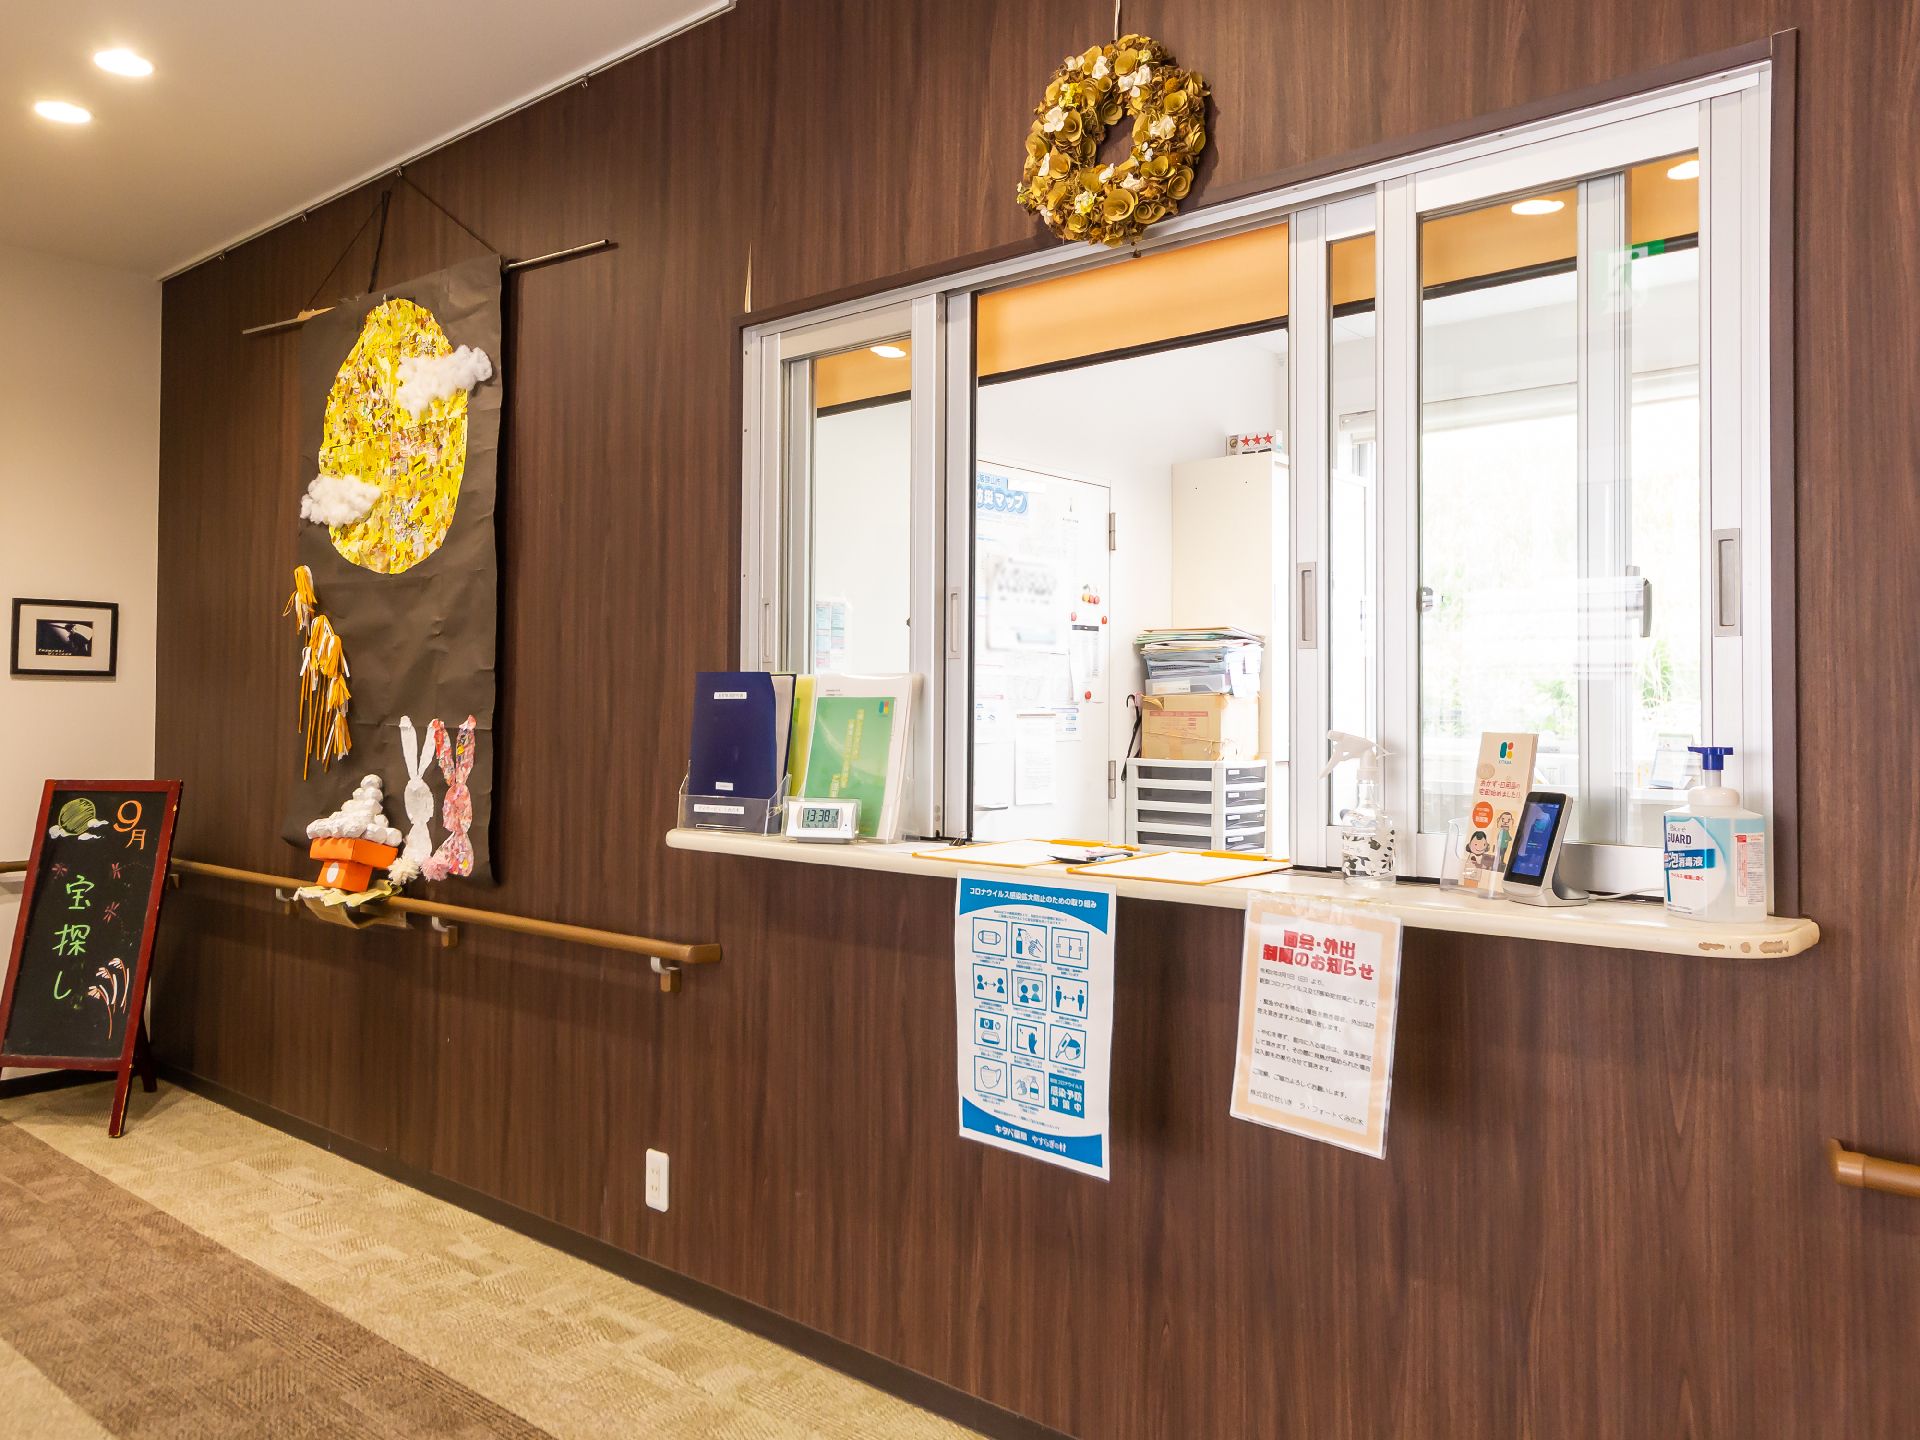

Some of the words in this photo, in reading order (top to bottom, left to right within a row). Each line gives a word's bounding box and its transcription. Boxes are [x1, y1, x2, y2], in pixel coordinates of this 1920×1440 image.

[113, 799, 147, 850] 9月
[969, 887, 1097, 909] コロナウイルス感染拡大防止のための取り組み
[52, 874, 95, 1001] 宝探し
[1284, 930, 1356, 960] 面会・外出
[1262, 943, 1374, 981] 制限のお知らせ
[1050, 1085, 1083, 1103] 感染予防
